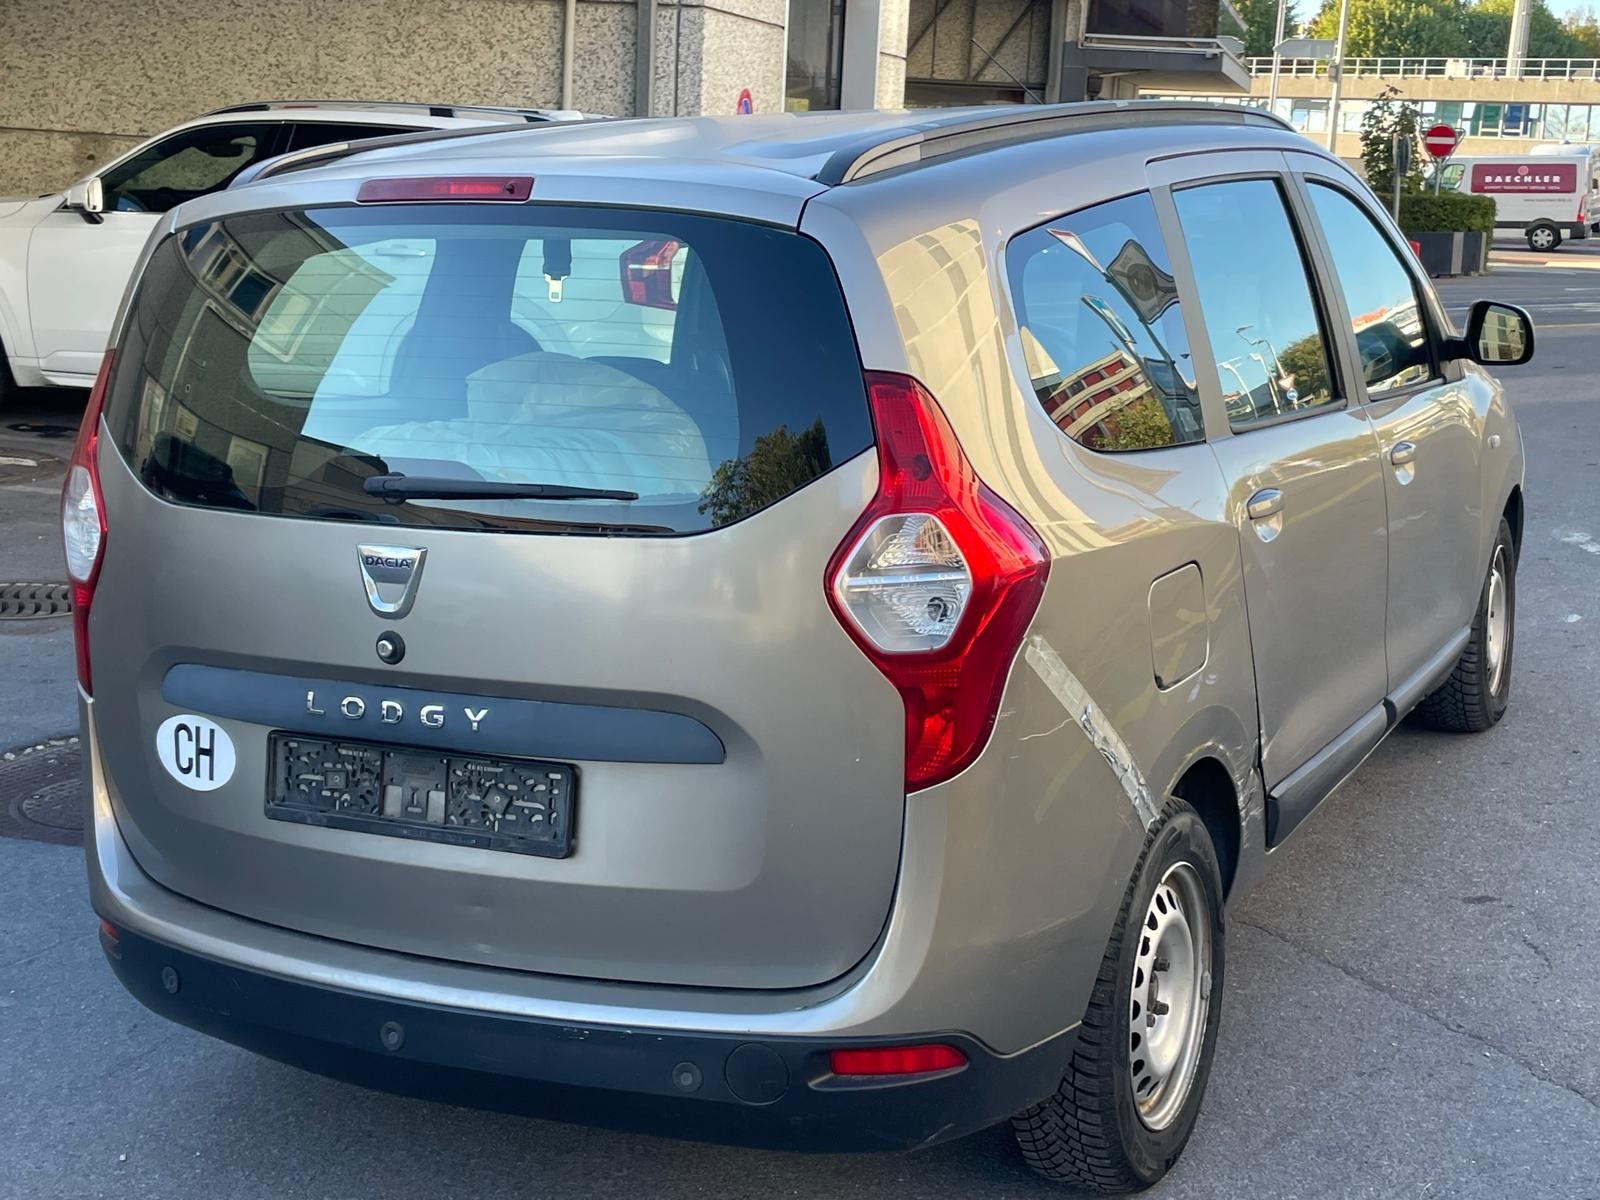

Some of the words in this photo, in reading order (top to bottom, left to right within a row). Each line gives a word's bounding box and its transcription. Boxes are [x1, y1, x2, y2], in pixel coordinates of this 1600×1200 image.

[1484, 175, 1561, 183] BAECHLER
[365, 556, 411, 568] DACIA
[306, 691, 489, 731] LODGY
[174, 723, 216, 781] CH
